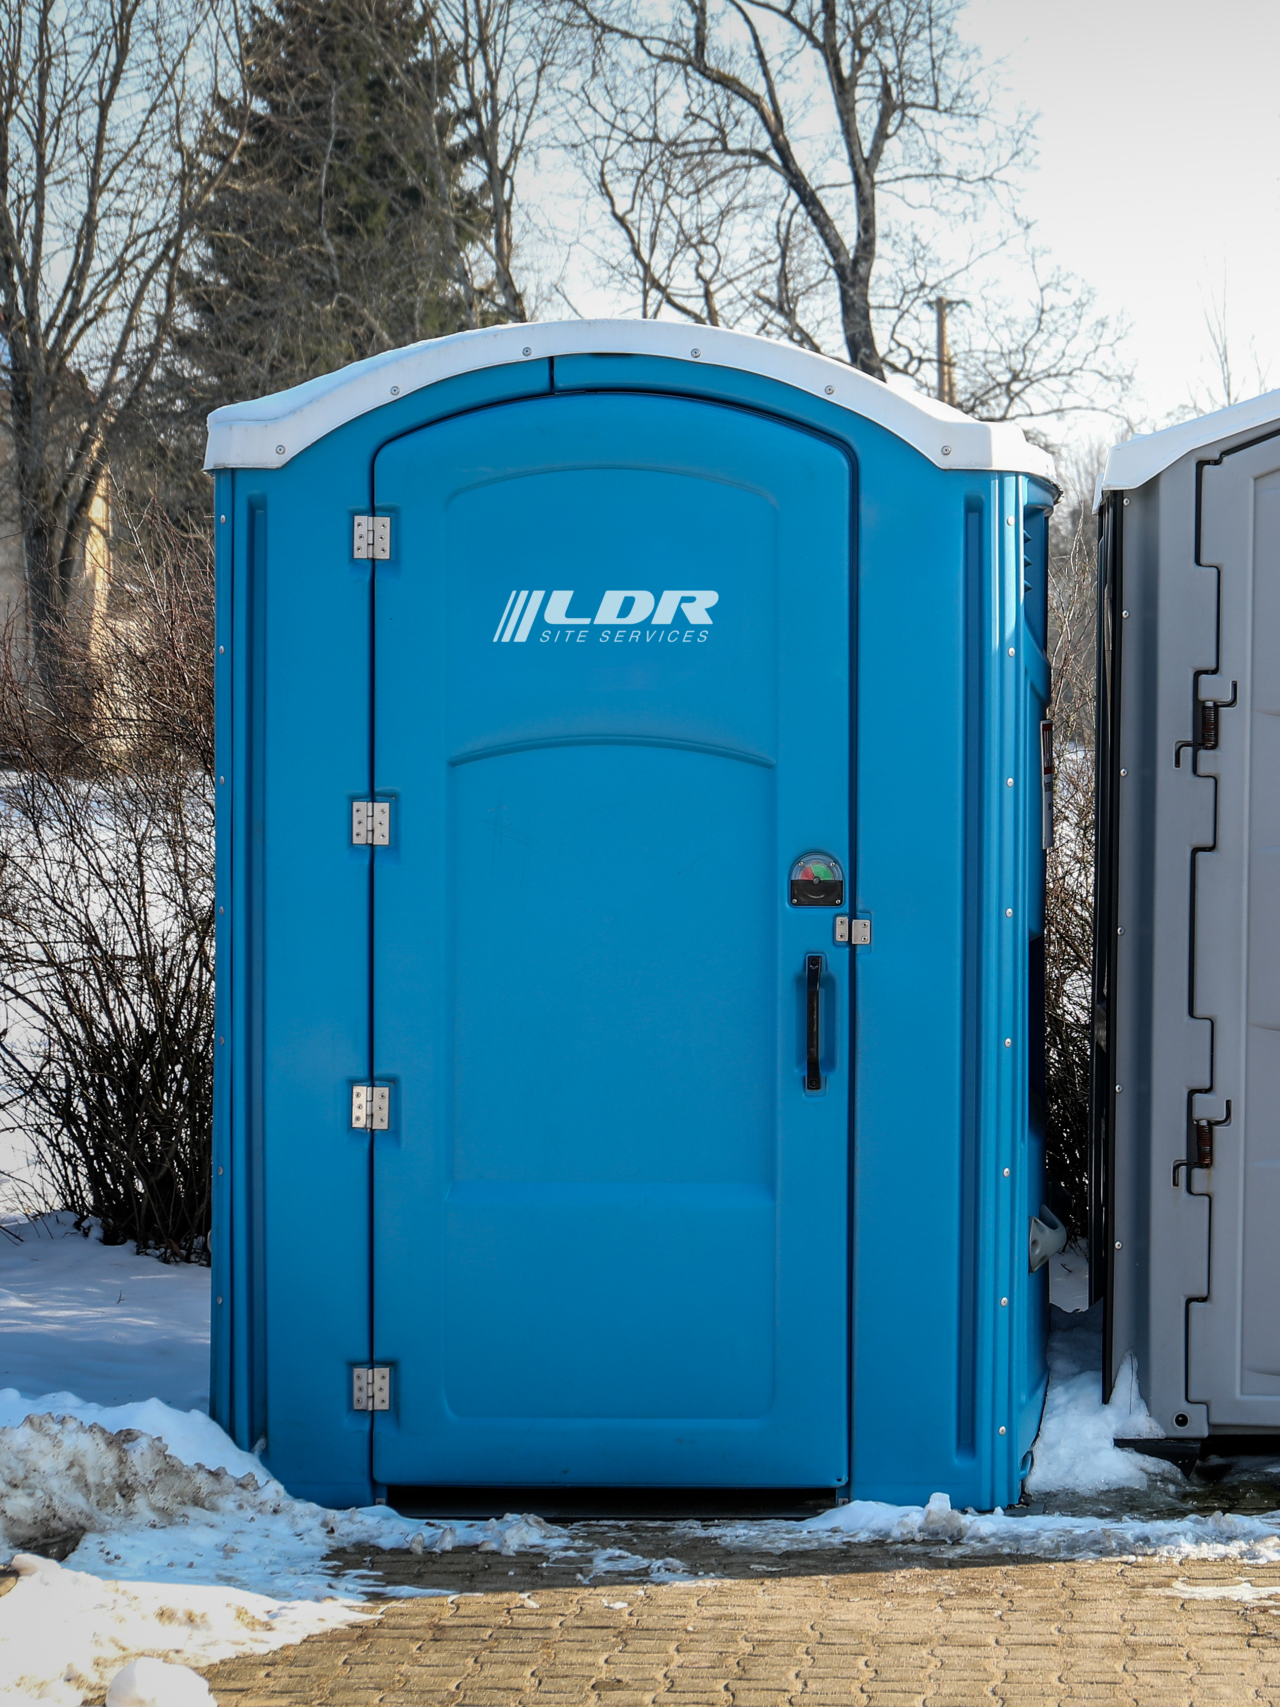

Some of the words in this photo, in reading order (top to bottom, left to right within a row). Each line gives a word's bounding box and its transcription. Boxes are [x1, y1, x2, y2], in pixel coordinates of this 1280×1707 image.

[544, 590, 719, 624] LDR
[539, 630, 589, 643] SITE
[599, 630, 709, 643] SERVICES
